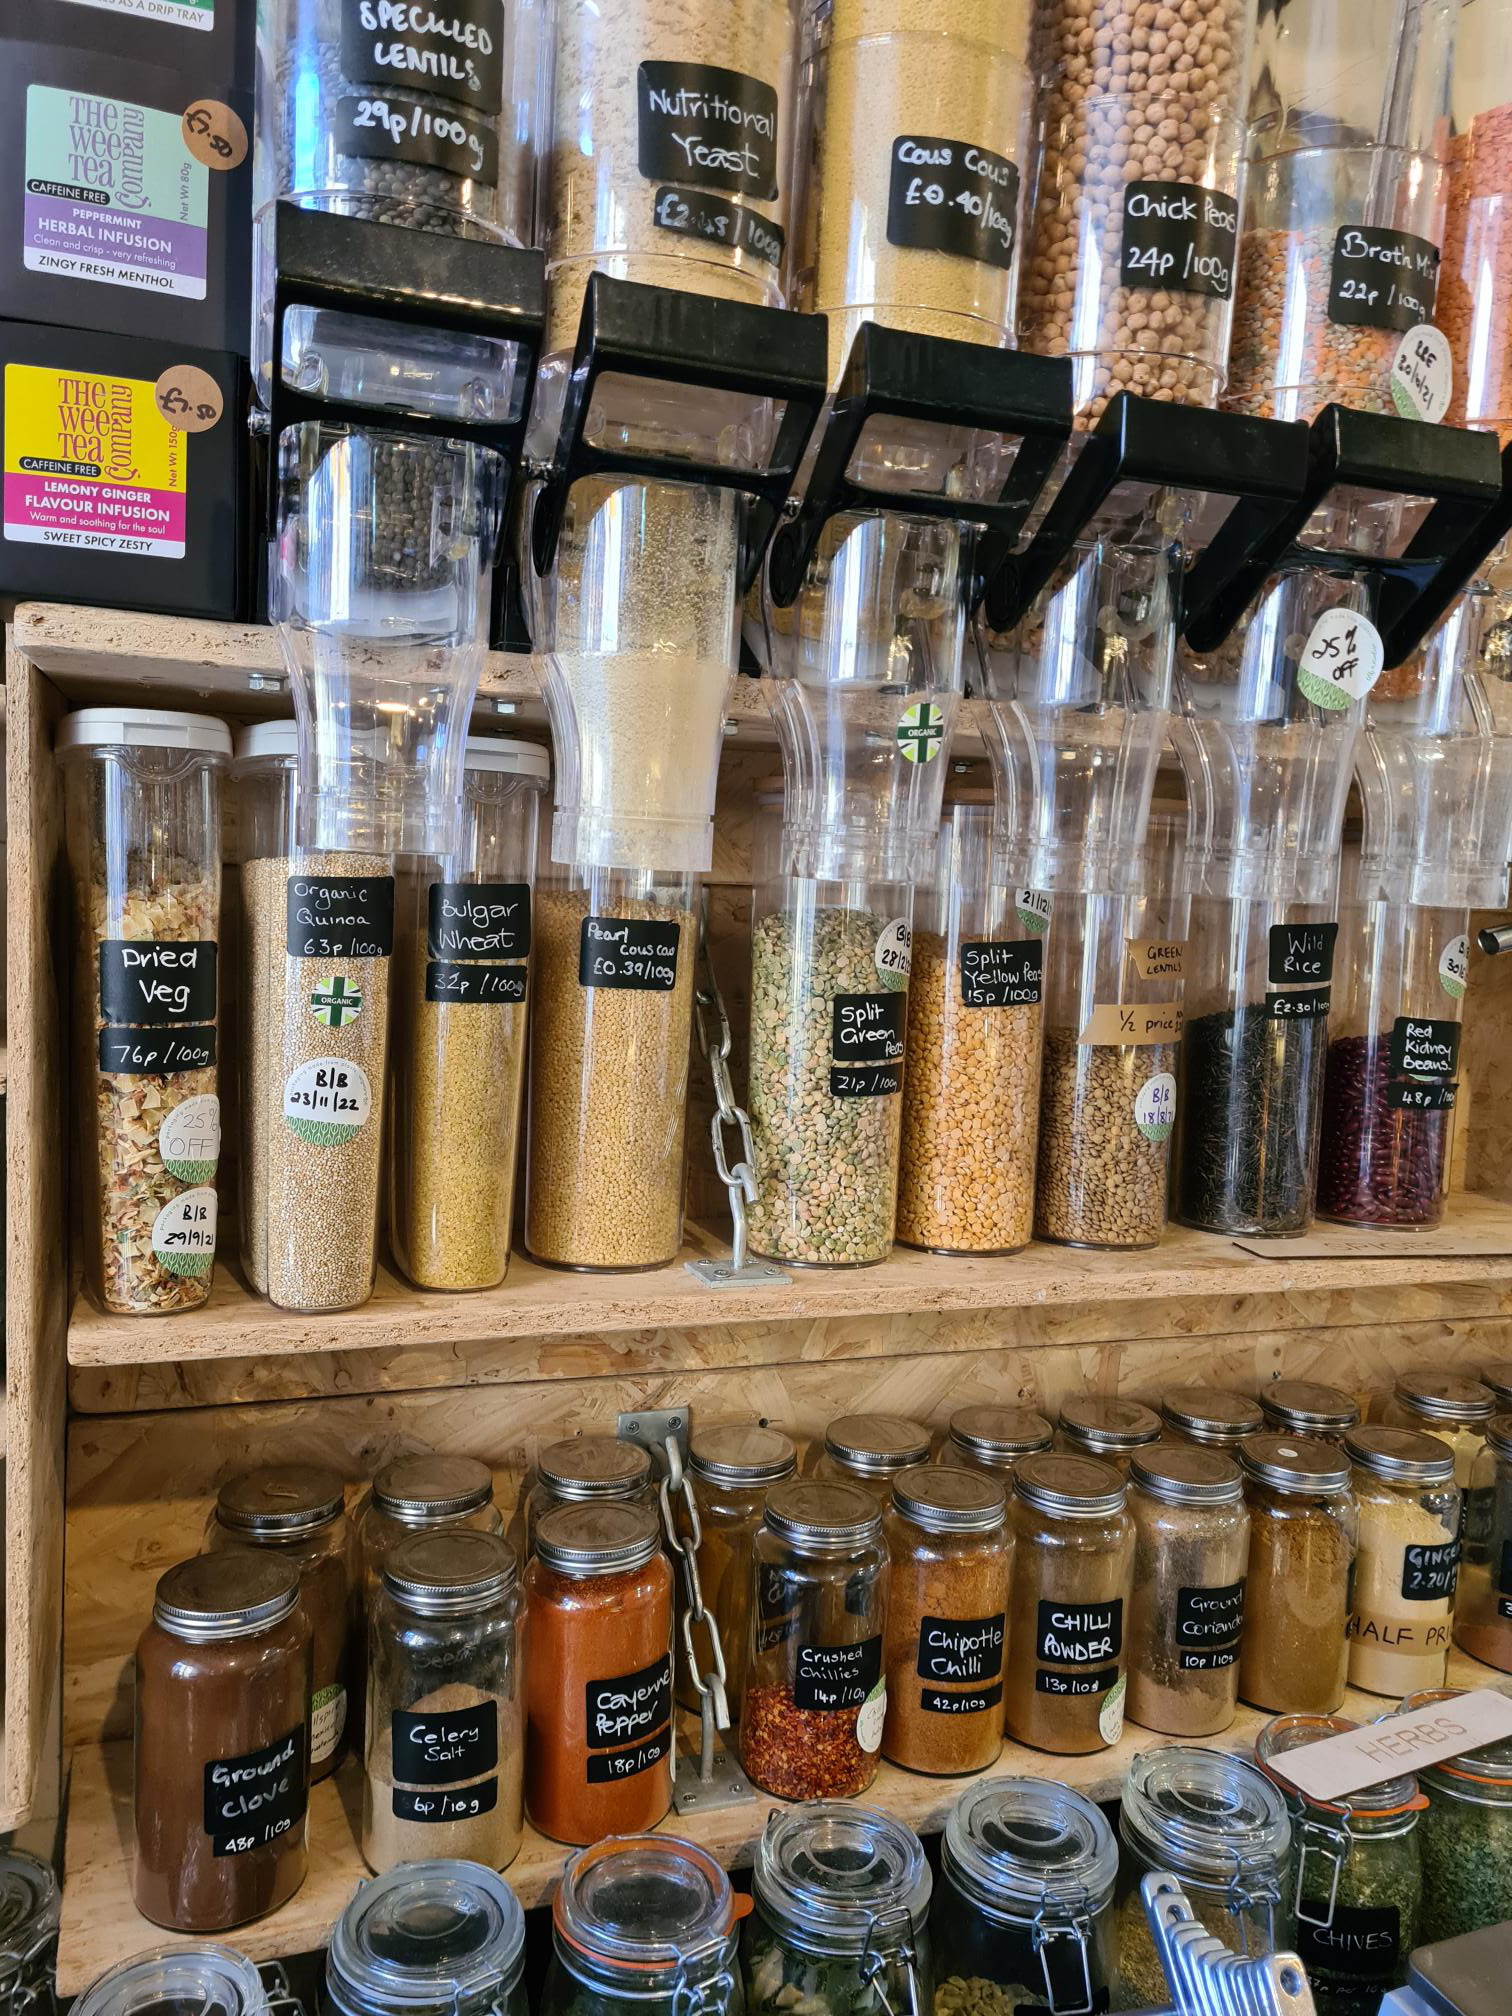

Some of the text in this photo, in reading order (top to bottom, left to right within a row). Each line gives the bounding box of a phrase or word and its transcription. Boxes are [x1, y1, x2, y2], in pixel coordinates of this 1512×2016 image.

[148, 2, 174, 16] DRIP
[176, 8, 204, 23] TRAY
[374, 42, 482, 92] LENTILS
[650, 88, 775, 142] Nutritional
[671, 131, 760, 180] Yeast
[898, 141, 1009, 186] Cous Cous
[31, 181, 106, 204] CAFFEINE FREE
[73, 208, 142, 229] PEPPERMINT
[1128, 194, 1235, 233] Chick Peas
[38, 217, 172, 253] HERBAL INFUSION
[33, 234, 176, 270] Clean and crisp very refreshing
[1341, 232, 1412, 269] Broth
[39, 256, 174, 289] ZINGY FRESH MENTHOL
[23, 459, 98, 476] CAFFEINE FREE
[168, 452, 177, 468] Wt
[168, 472, 177, 488] Net
[44, 481, 152, 504] LEMONY GINGER
[25, 495, 170, 522] FLAVOUR INFUSION
[29, 511, 166, 534] Warm and soothing for the soul
[43, 531, 153, 551] SWEET SPICY ZESTY
[908, 728, 937, 737] ORGANIC
[295, 883, 368, 911] Organic
[297, 907, 371, 927] Quinoa
[442, 899, 518, 928] Bulgar
[440, 928, 515, 951] Wheat
[588, 922, 628, 943] Pearl
[1288, 932, 1323, 954] Wild
[122, 946, 197, 968] Dried
[966, 949, 1014, 971] Split
[1148, 946, 1183, 960] GREEN
[1147, 963, 1182, 974] LENTILS
[1284, 956, 1321, 974] Rice
[965, 969, 1019, 988] Yellow
[139, 980, 190, 1012] Veg
[321, 996, 353, 1006] ORGANIC
[841, 1002, 884, 1028] Split
[1146, 1011, 1173, 1033] price
[841, 1028, 895, 1044] Green
[1406, 1023, 1433, 1039] Red
[1405, 1039, 1452, 1061] Kidney
[316, 1067, 348, 1090] B/B
[290, 1090, 359, 1113] 23/11/22
[1152, 1084, 1170, 1105] B/B
[184, 1108, 218, 1132] 25%
[170, 1138, 214, 1157] OFF
[183, 1205, 207, 1222] B/B
[1052, 1612, 1112, 1632] CHILLI
[1345, 1616, 1449, 1646] HALF PRI
[928, 1626, 1004, 1658] Chipotle
[1044, 1633, 1113, 1661] POWDER
[802, 1646, 863, 1663] Crushed
[931, 1654, 982, 1677] Chilli
[800, 1667, 859, 1680] Chillies
[597, 1669, 670, 1711] Cayenne
[596, 1701, 658, 1736] Pepper
[410, 1725, 479, 1743] Celery
[1355, 1717, 1468, 1764] HERBS
[212, 1739, 294, 1788] Ground
[424, 1745, 465, 1761] Salt
[222, 1778, 288, 1818] Clove
[1313, 1927, 1393, 1951] CHIVES
